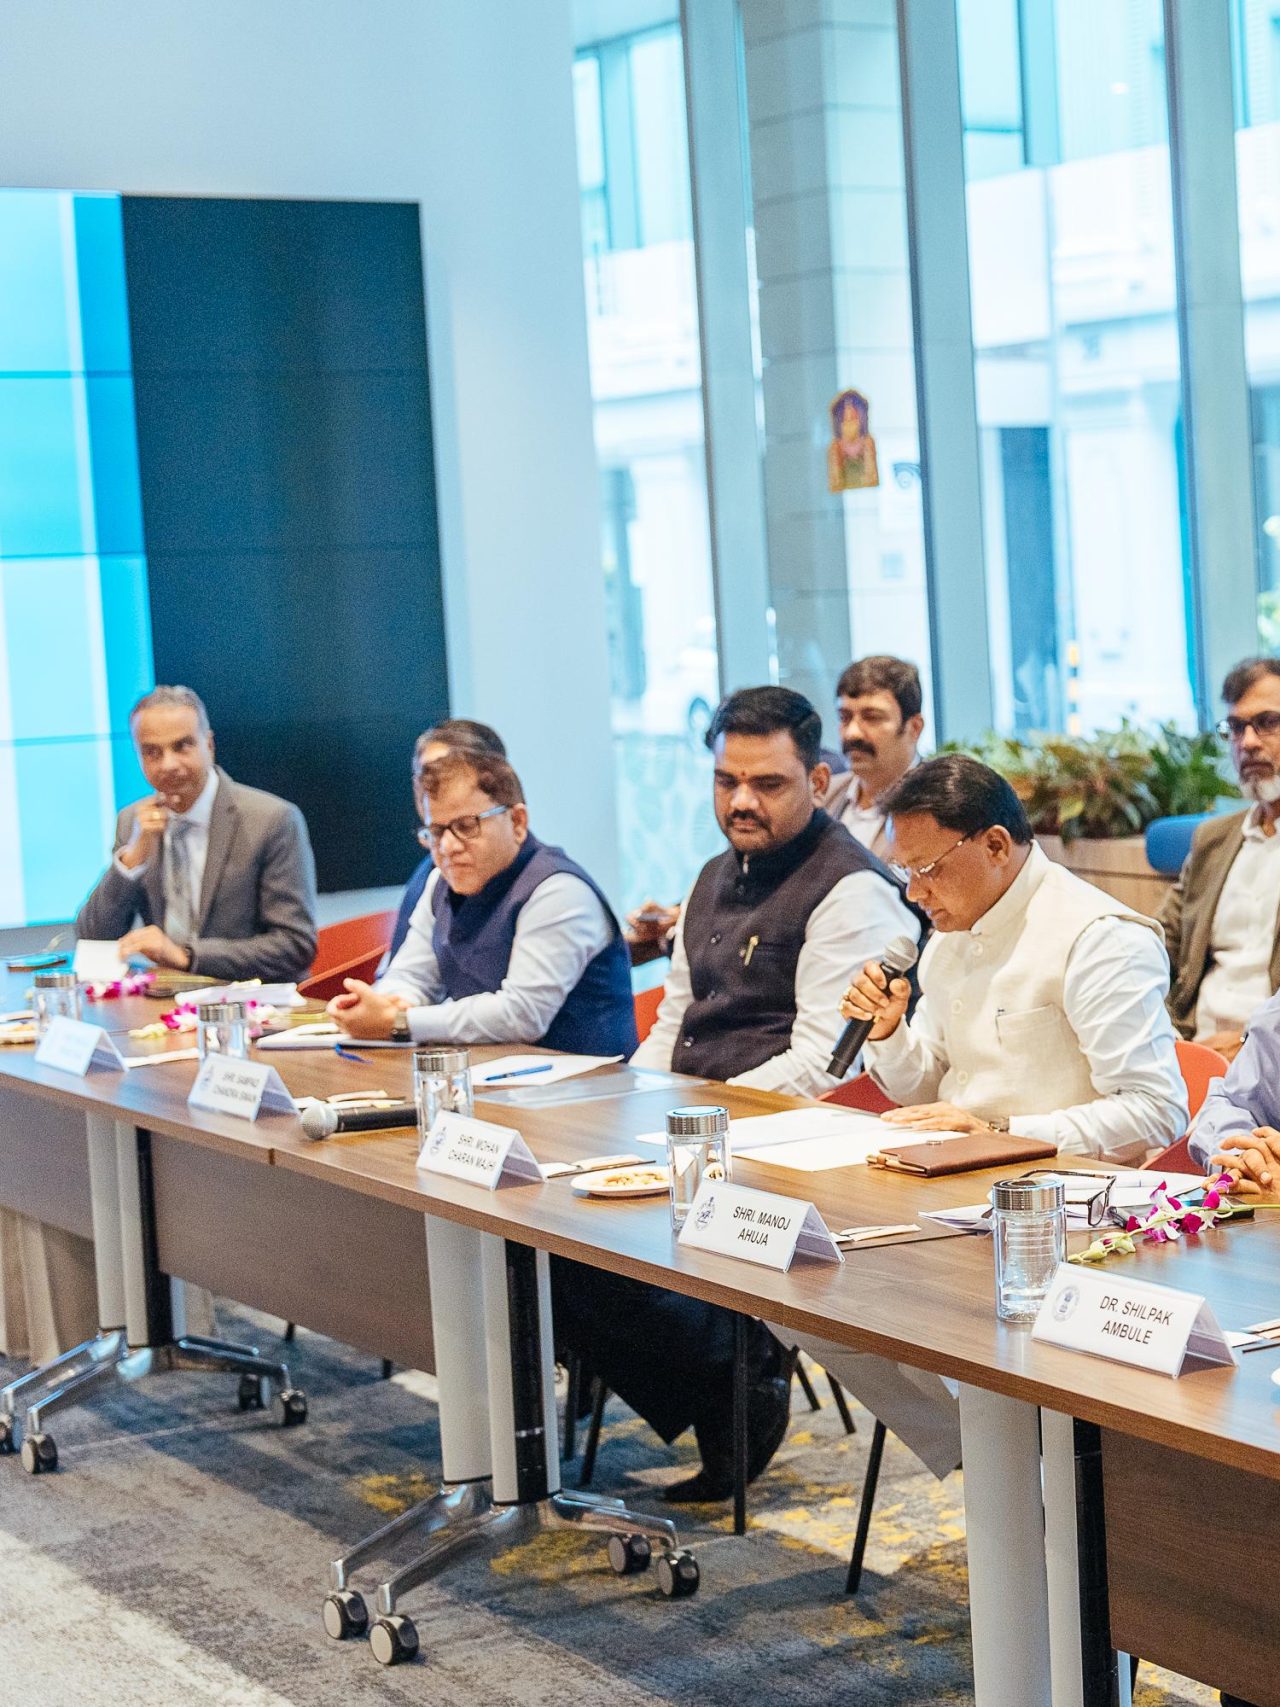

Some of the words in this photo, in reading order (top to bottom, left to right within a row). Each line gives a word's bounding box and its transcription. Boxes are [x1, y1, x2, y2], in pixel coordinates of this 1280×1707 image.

[733, 1206, 755, 1222] SHRI.
[757, 1212, 791, 1231] MANOJ
[738, 1228, 769, 1246] AHUJA
[1100, 1295, 1119, 1313] DR.
[1122, 1301, 1173, 1326] SHILPAK
[1101, 1320, 1153, 1345] AMBULE
